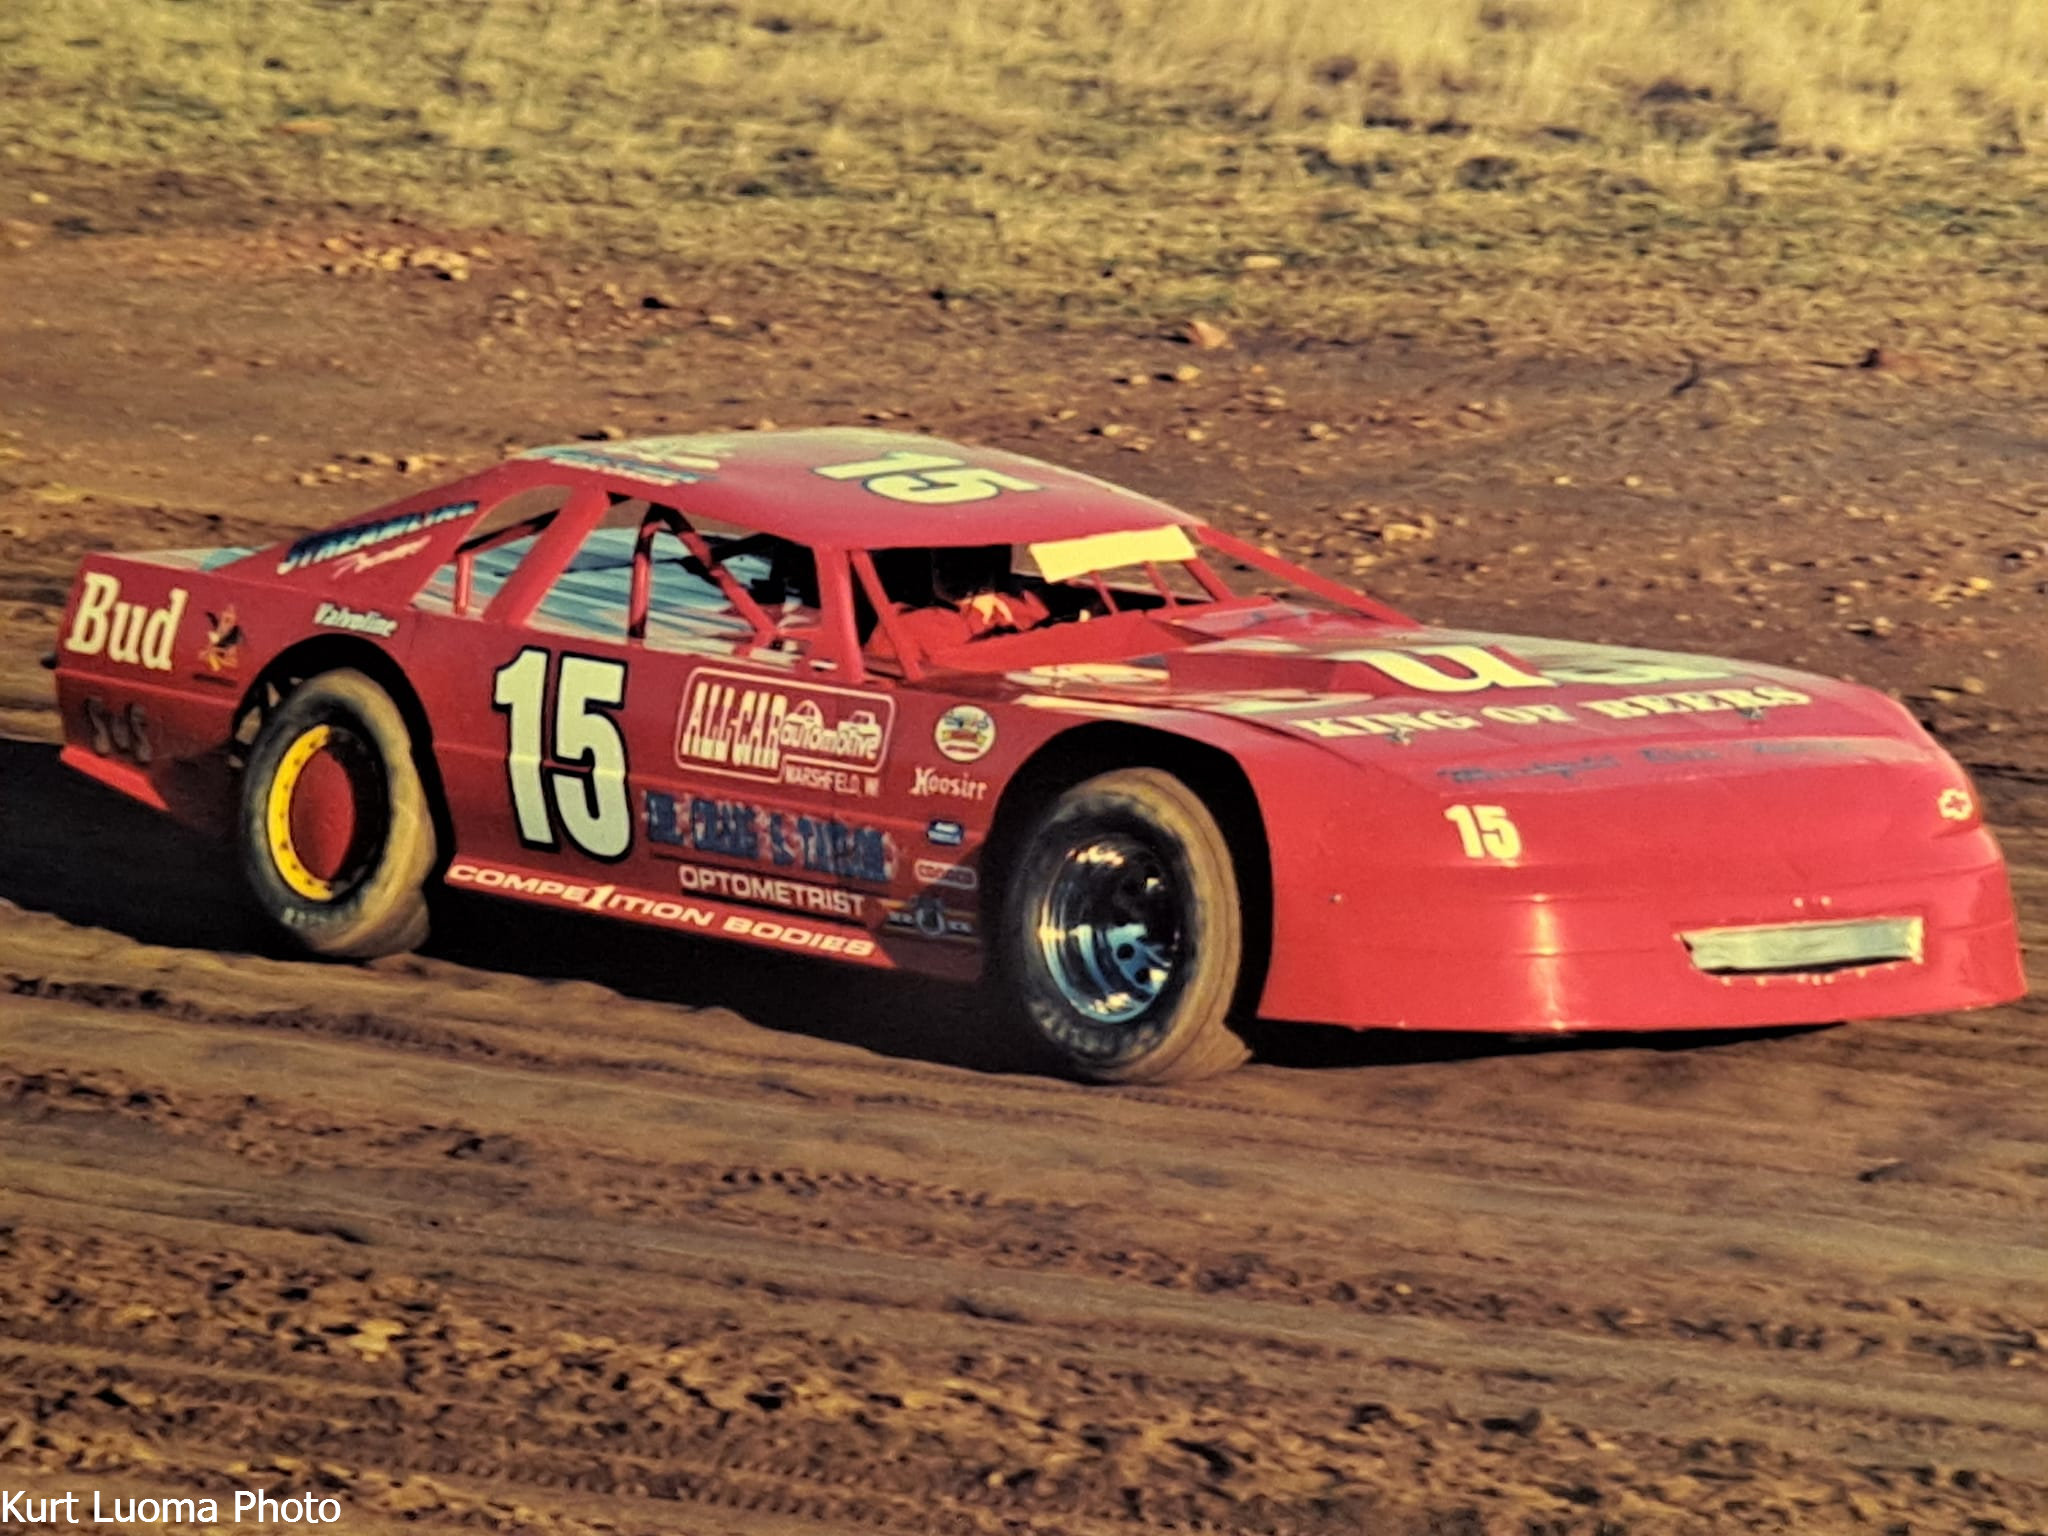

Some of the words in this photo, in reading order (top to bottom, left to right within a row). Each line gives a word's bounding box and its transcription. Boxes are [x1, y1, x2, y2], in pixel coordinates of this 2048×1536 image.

[811, 451, 1043, 504] 15
[65, 571, 189, 671] Bud
[680, 681, 788, 770] ALL-CAR
[1288, 707, 1482, 738] KING
[1482, 703, 1576, 724] OF
[1577, 685, 1812, 719] BEERS
[492, 646, 632, 863] 15
[1445, 805, 1523, 862] 15
[679, 864, 866, 917] OPTOMETRIST
[722, 916, 875, 957] BODIES
